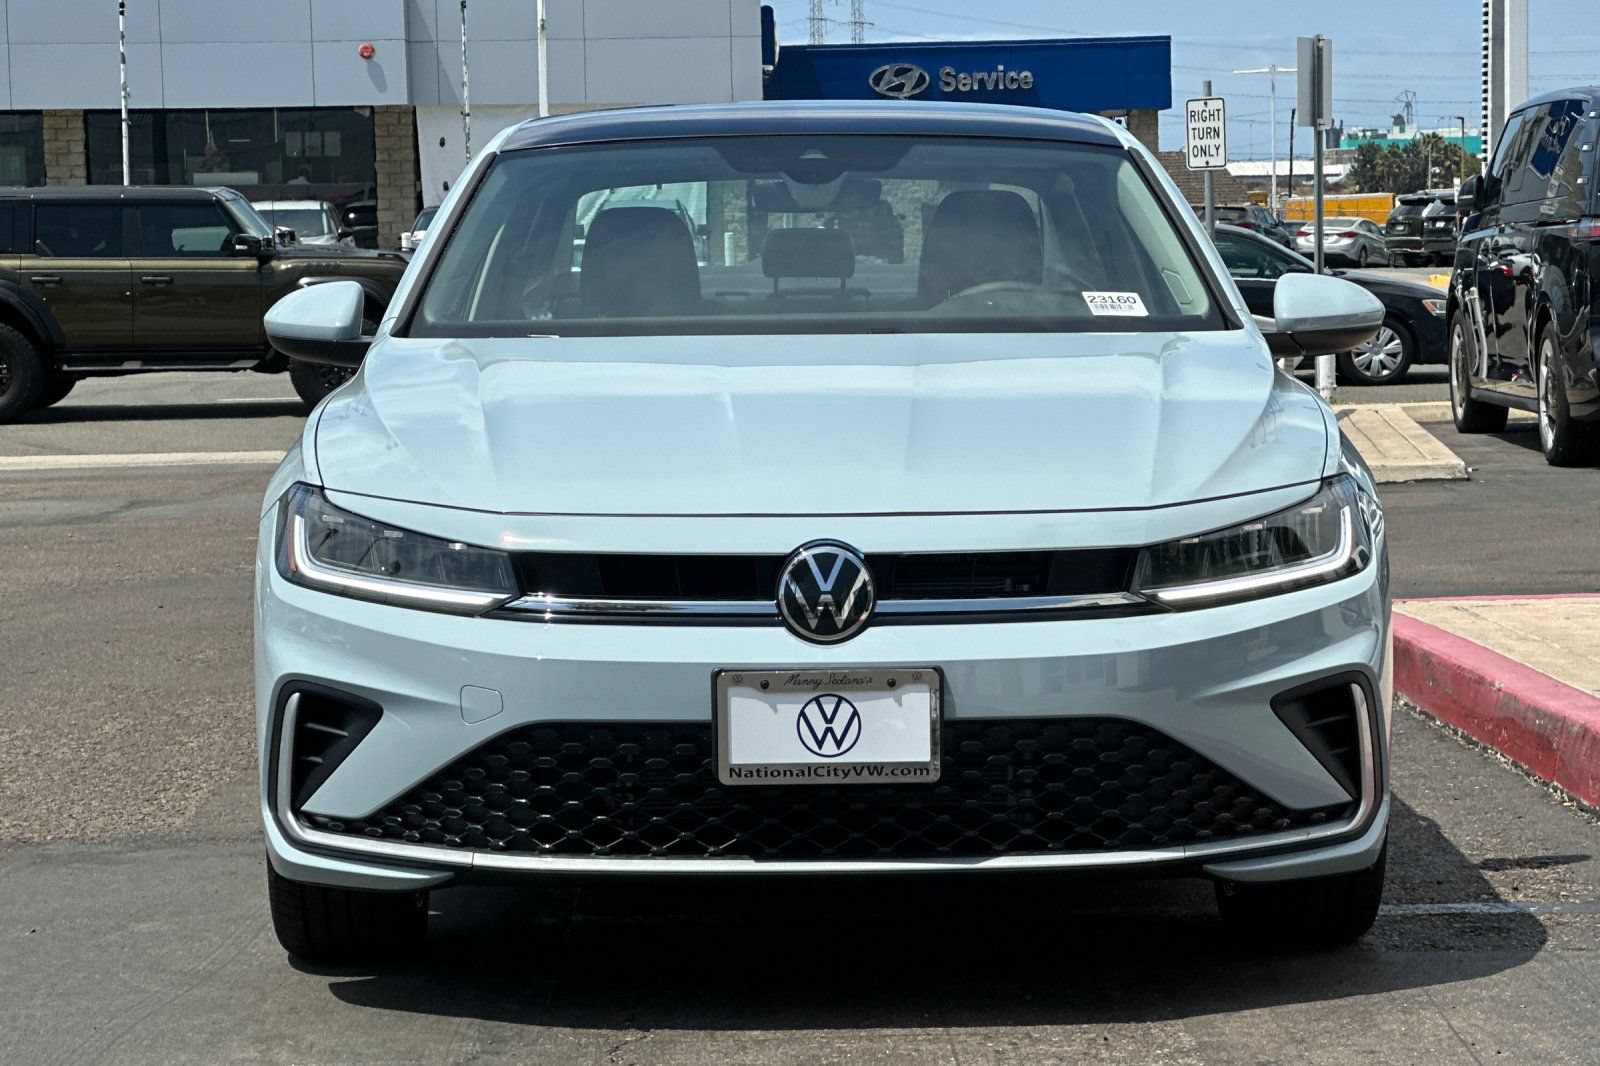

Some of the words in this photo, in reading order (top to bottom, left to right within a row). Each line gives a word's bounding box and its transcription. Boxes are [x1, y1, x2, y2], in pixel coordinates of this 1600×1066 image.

[938, 64, 1034, 92] Service
[1189, 108, 1222, 123] RIGHT
[1191, 126, 1220, 140] TURN
[1192, 144, 1221, 158] ONLY
[1087, 295, 1137, 304] 23160
[783, 673, 823, 690] Manny
[729, 765, 930, 780] NationalCityVW.com
